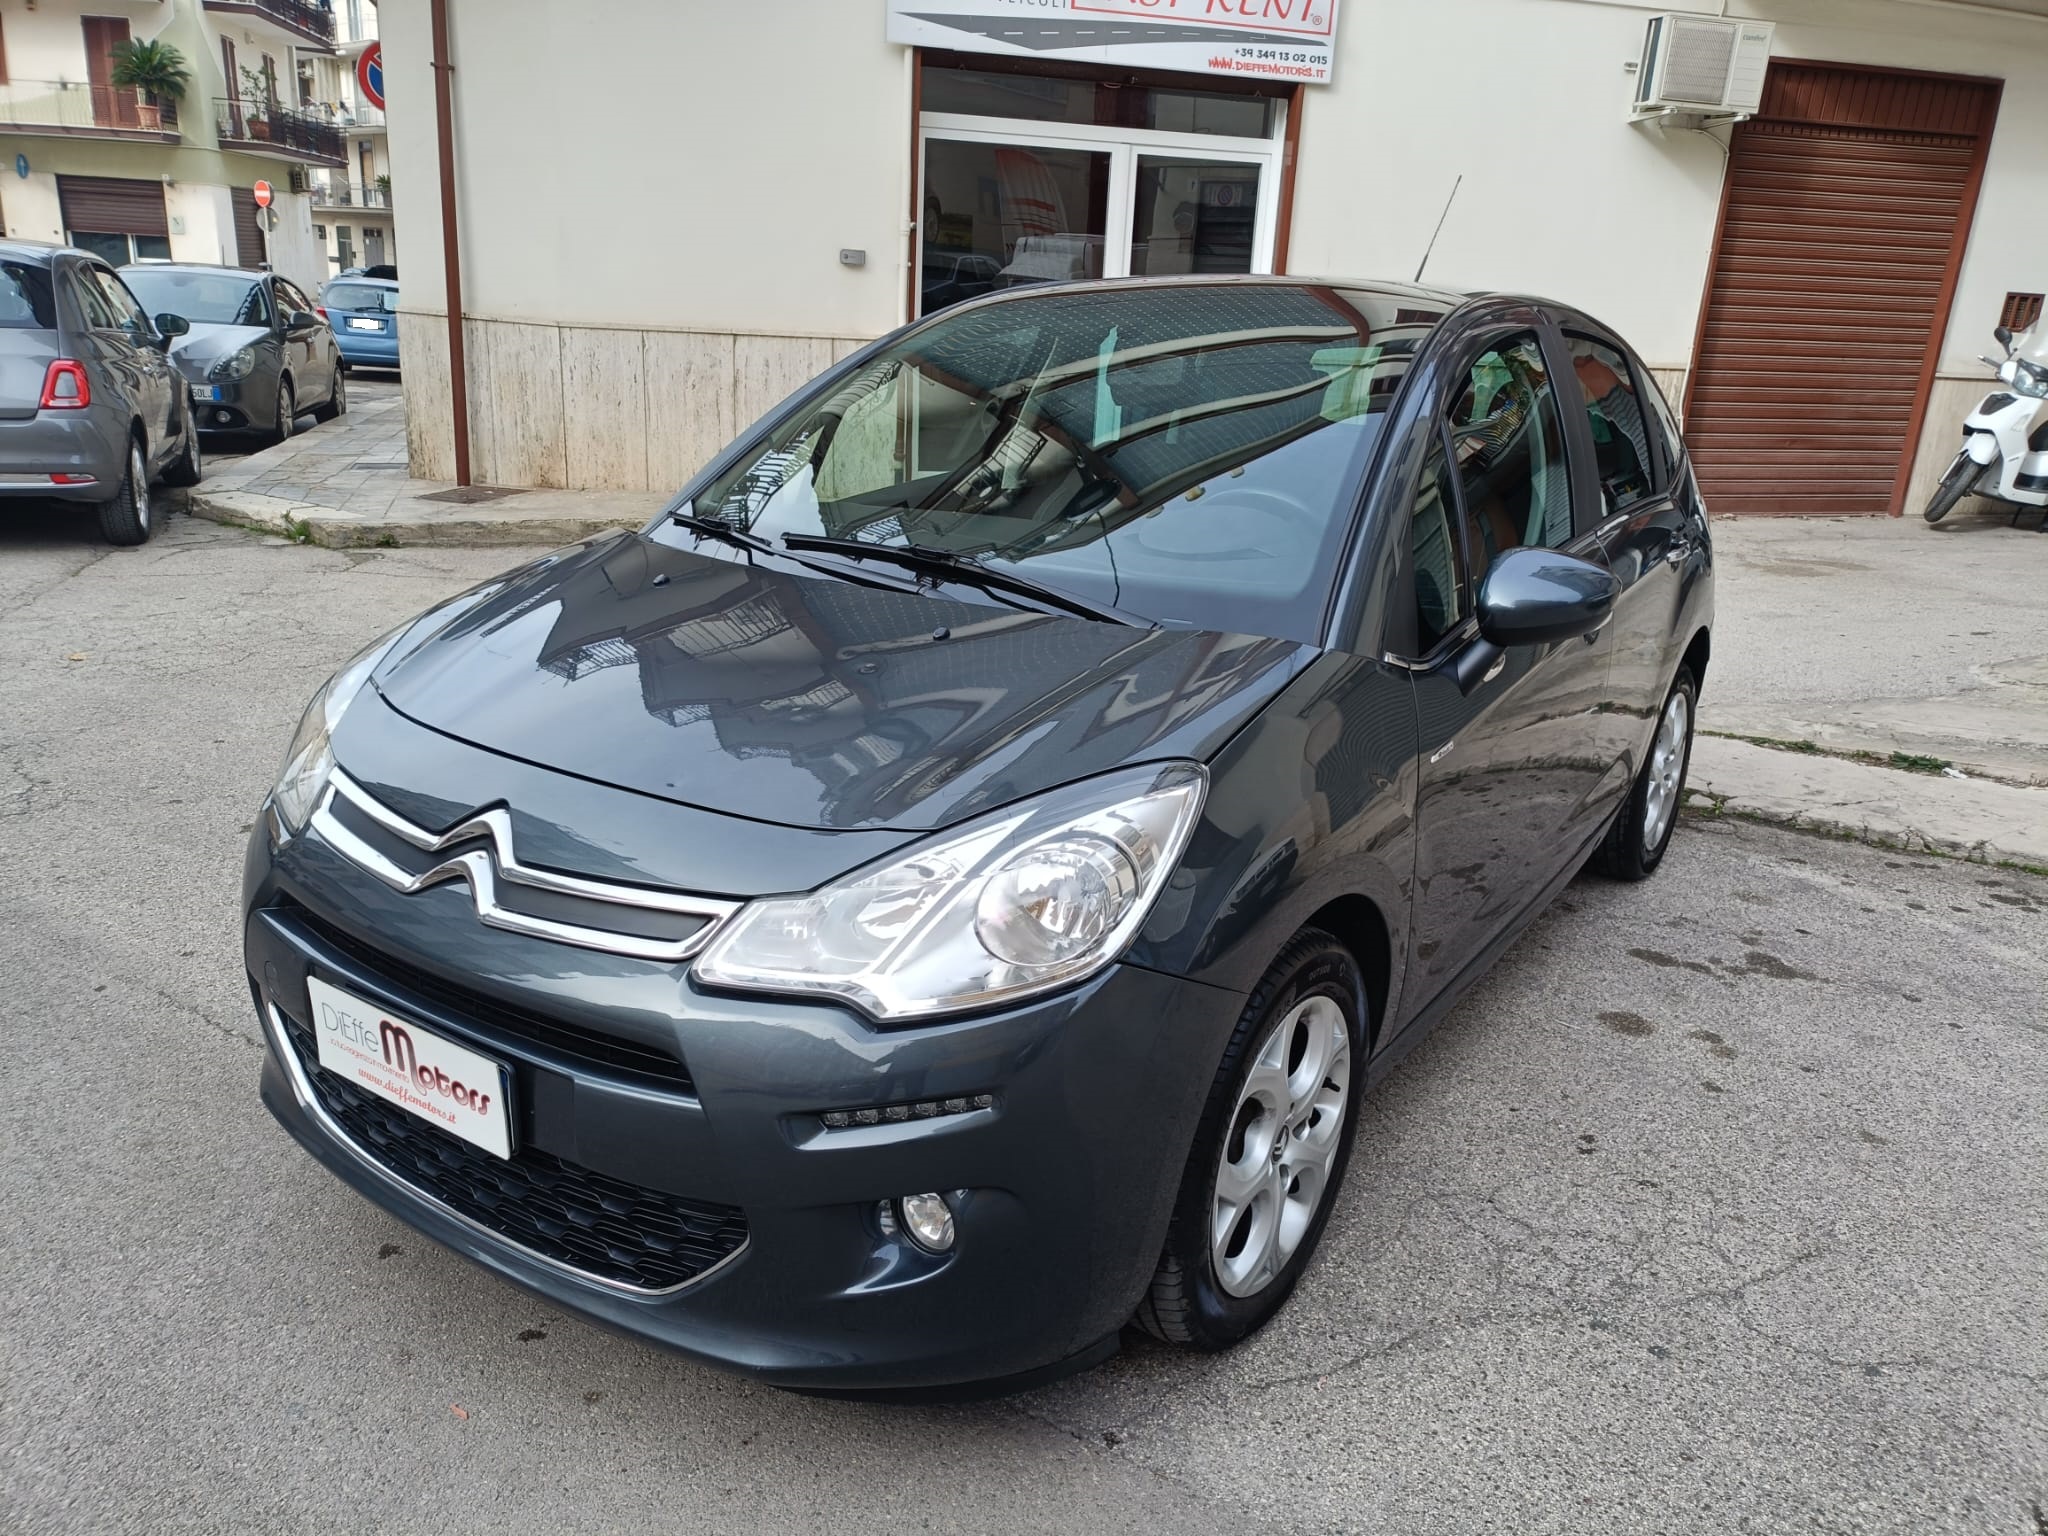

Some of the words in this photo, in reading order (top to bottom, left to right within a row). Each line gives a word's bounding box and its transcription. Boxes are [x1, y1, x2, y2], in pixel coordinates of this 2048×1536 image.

[1235, 48, 1254, 58] +39
[1256, 49, 1276, 60] 349
[1279, 52, 1290, 61] 13
[1292, 53, 1306, 63] 02
[1309, 55, 1328, 65] 015
[321, 1002, 379, 1053] DiEffe
